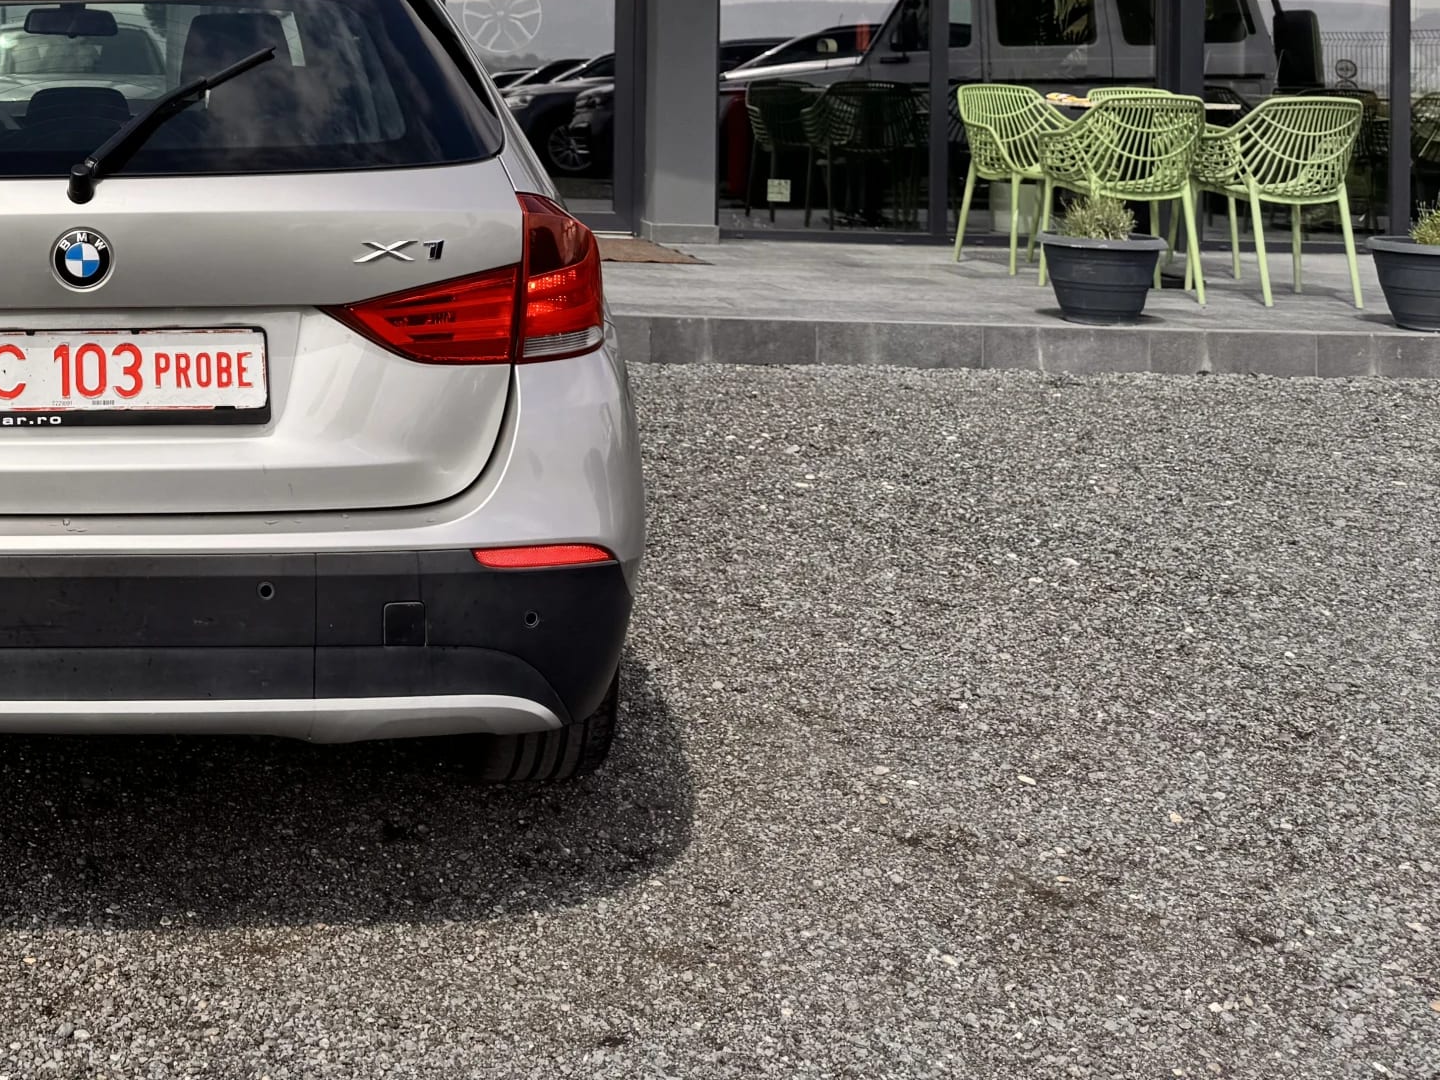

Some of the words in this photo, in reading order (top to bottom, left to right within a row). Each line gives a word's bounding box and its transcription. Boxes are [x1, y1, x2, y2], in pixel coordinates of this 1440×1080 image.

[59, 232, 106, 251] BMW
[353, 240, 445, 263] X1
[54, 342, 144, 400] 103
[154, 351, 253, 389] PROBE
